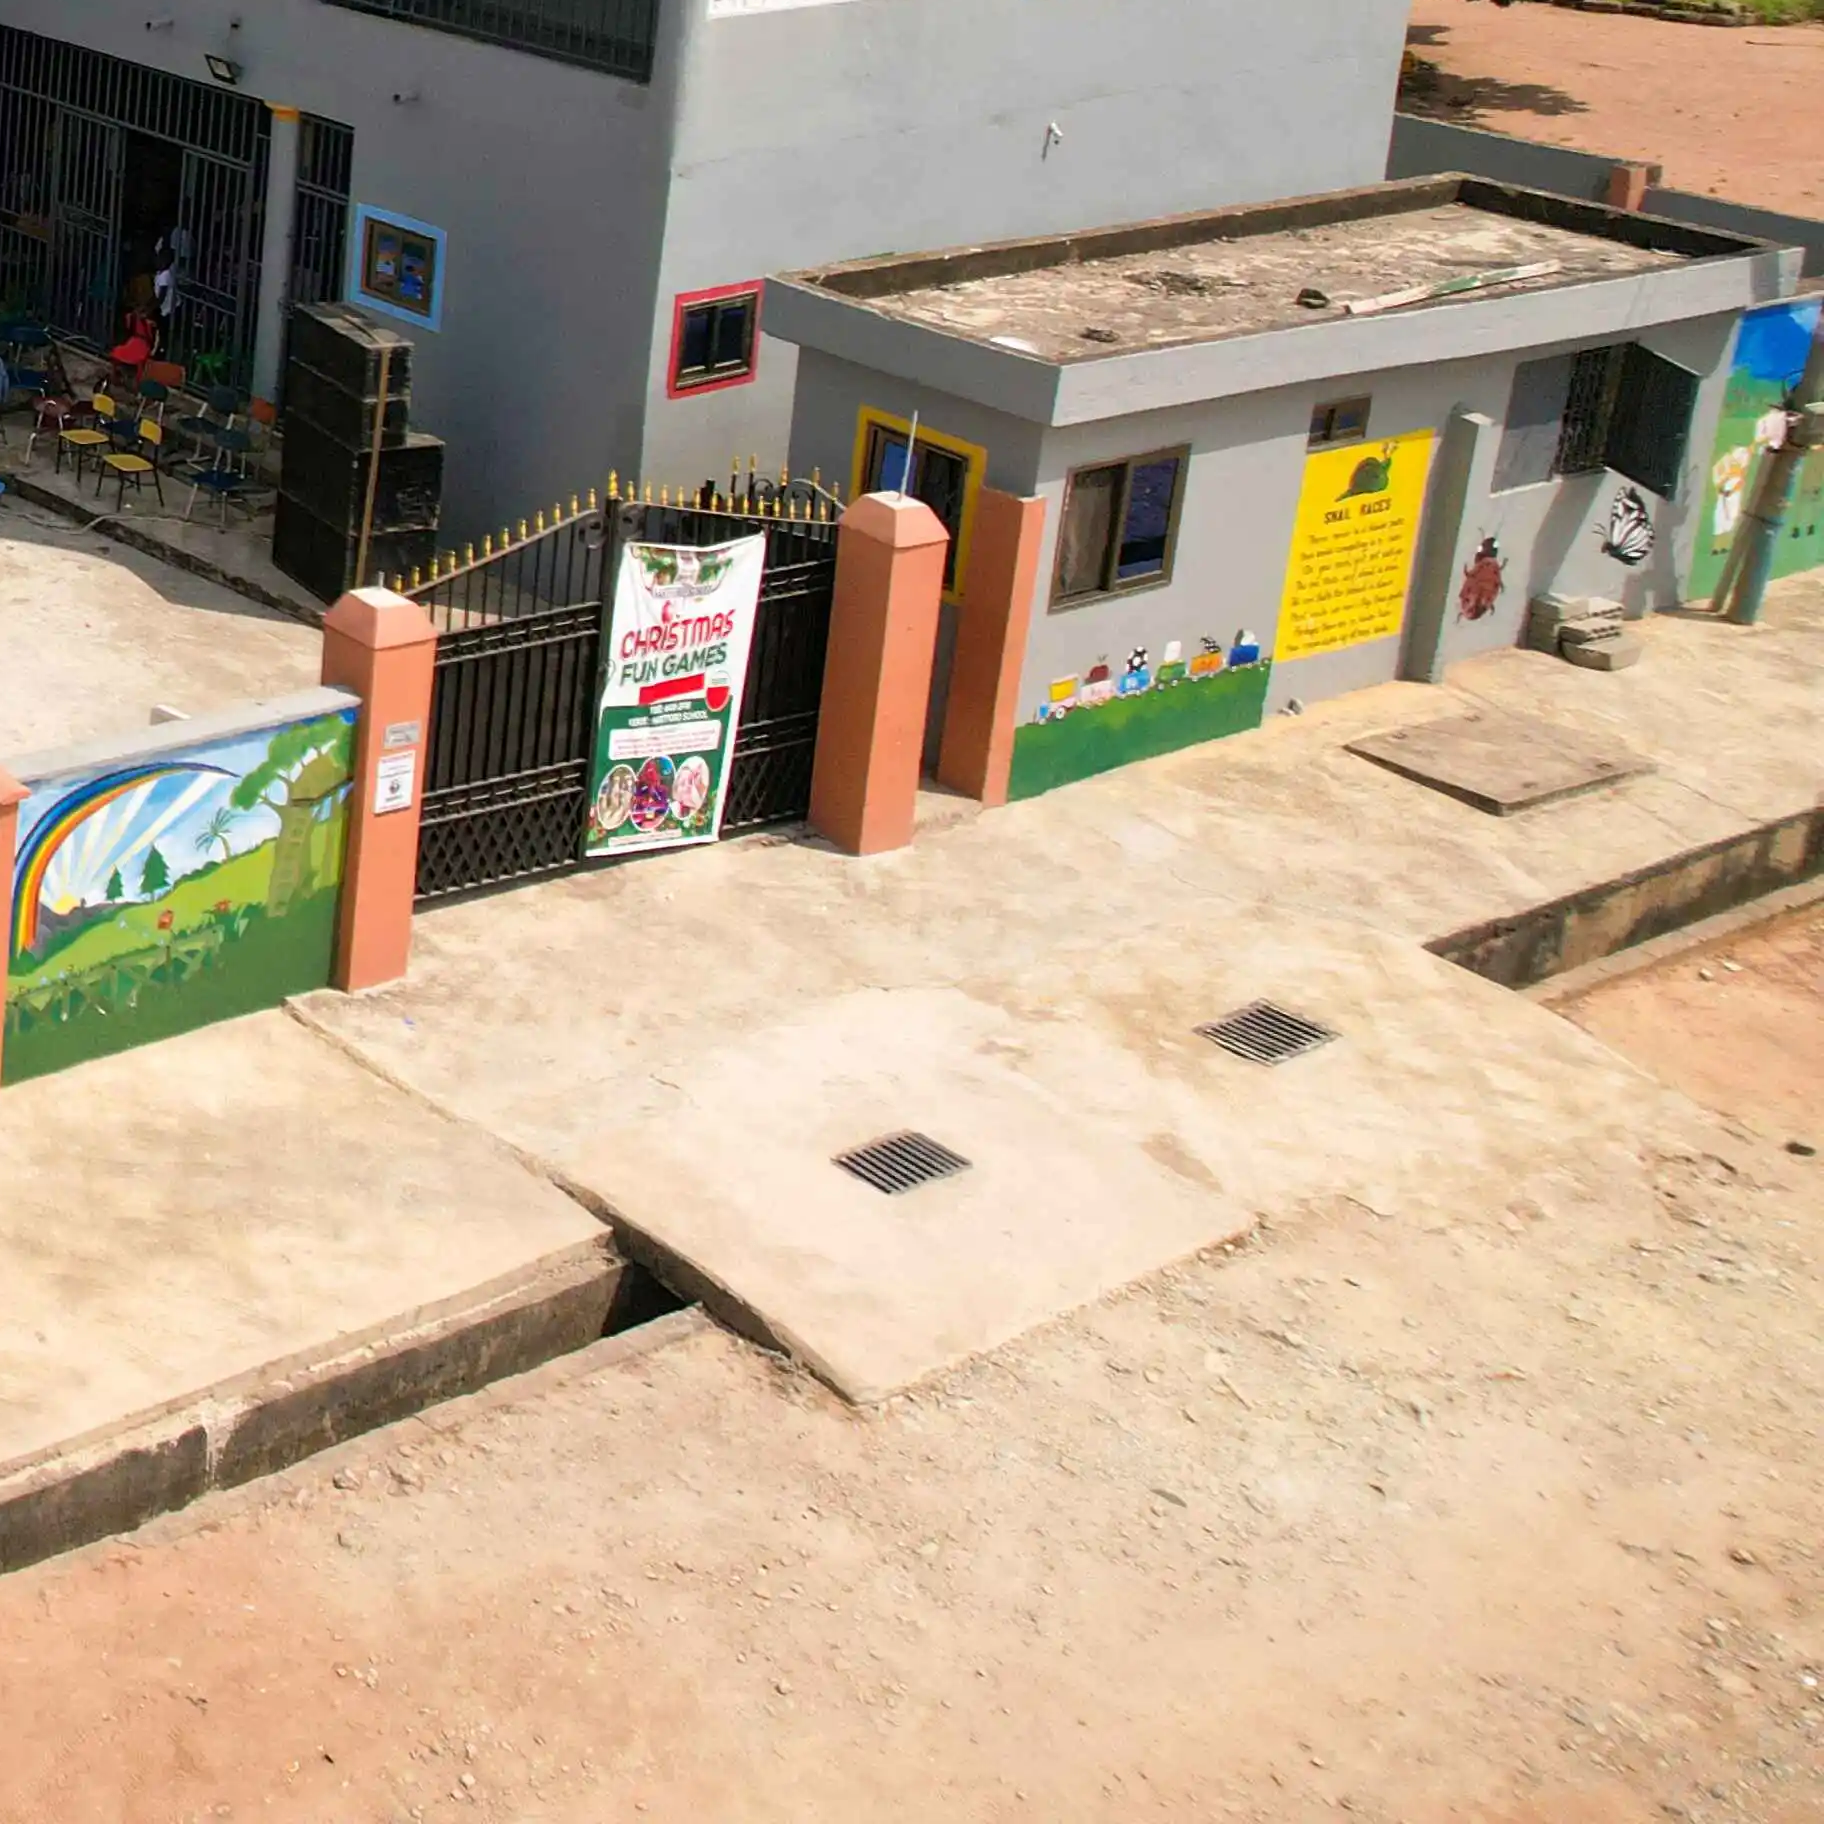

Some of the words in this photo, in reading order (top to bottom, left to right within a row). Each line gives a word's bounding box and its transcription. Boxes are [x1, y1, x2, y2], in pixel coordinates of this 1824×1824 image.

[621, 609, 736, 659] CHRISTMAS
[619, 657, 658, 687] FUN
[662, 642, 727, 676] GAMES
